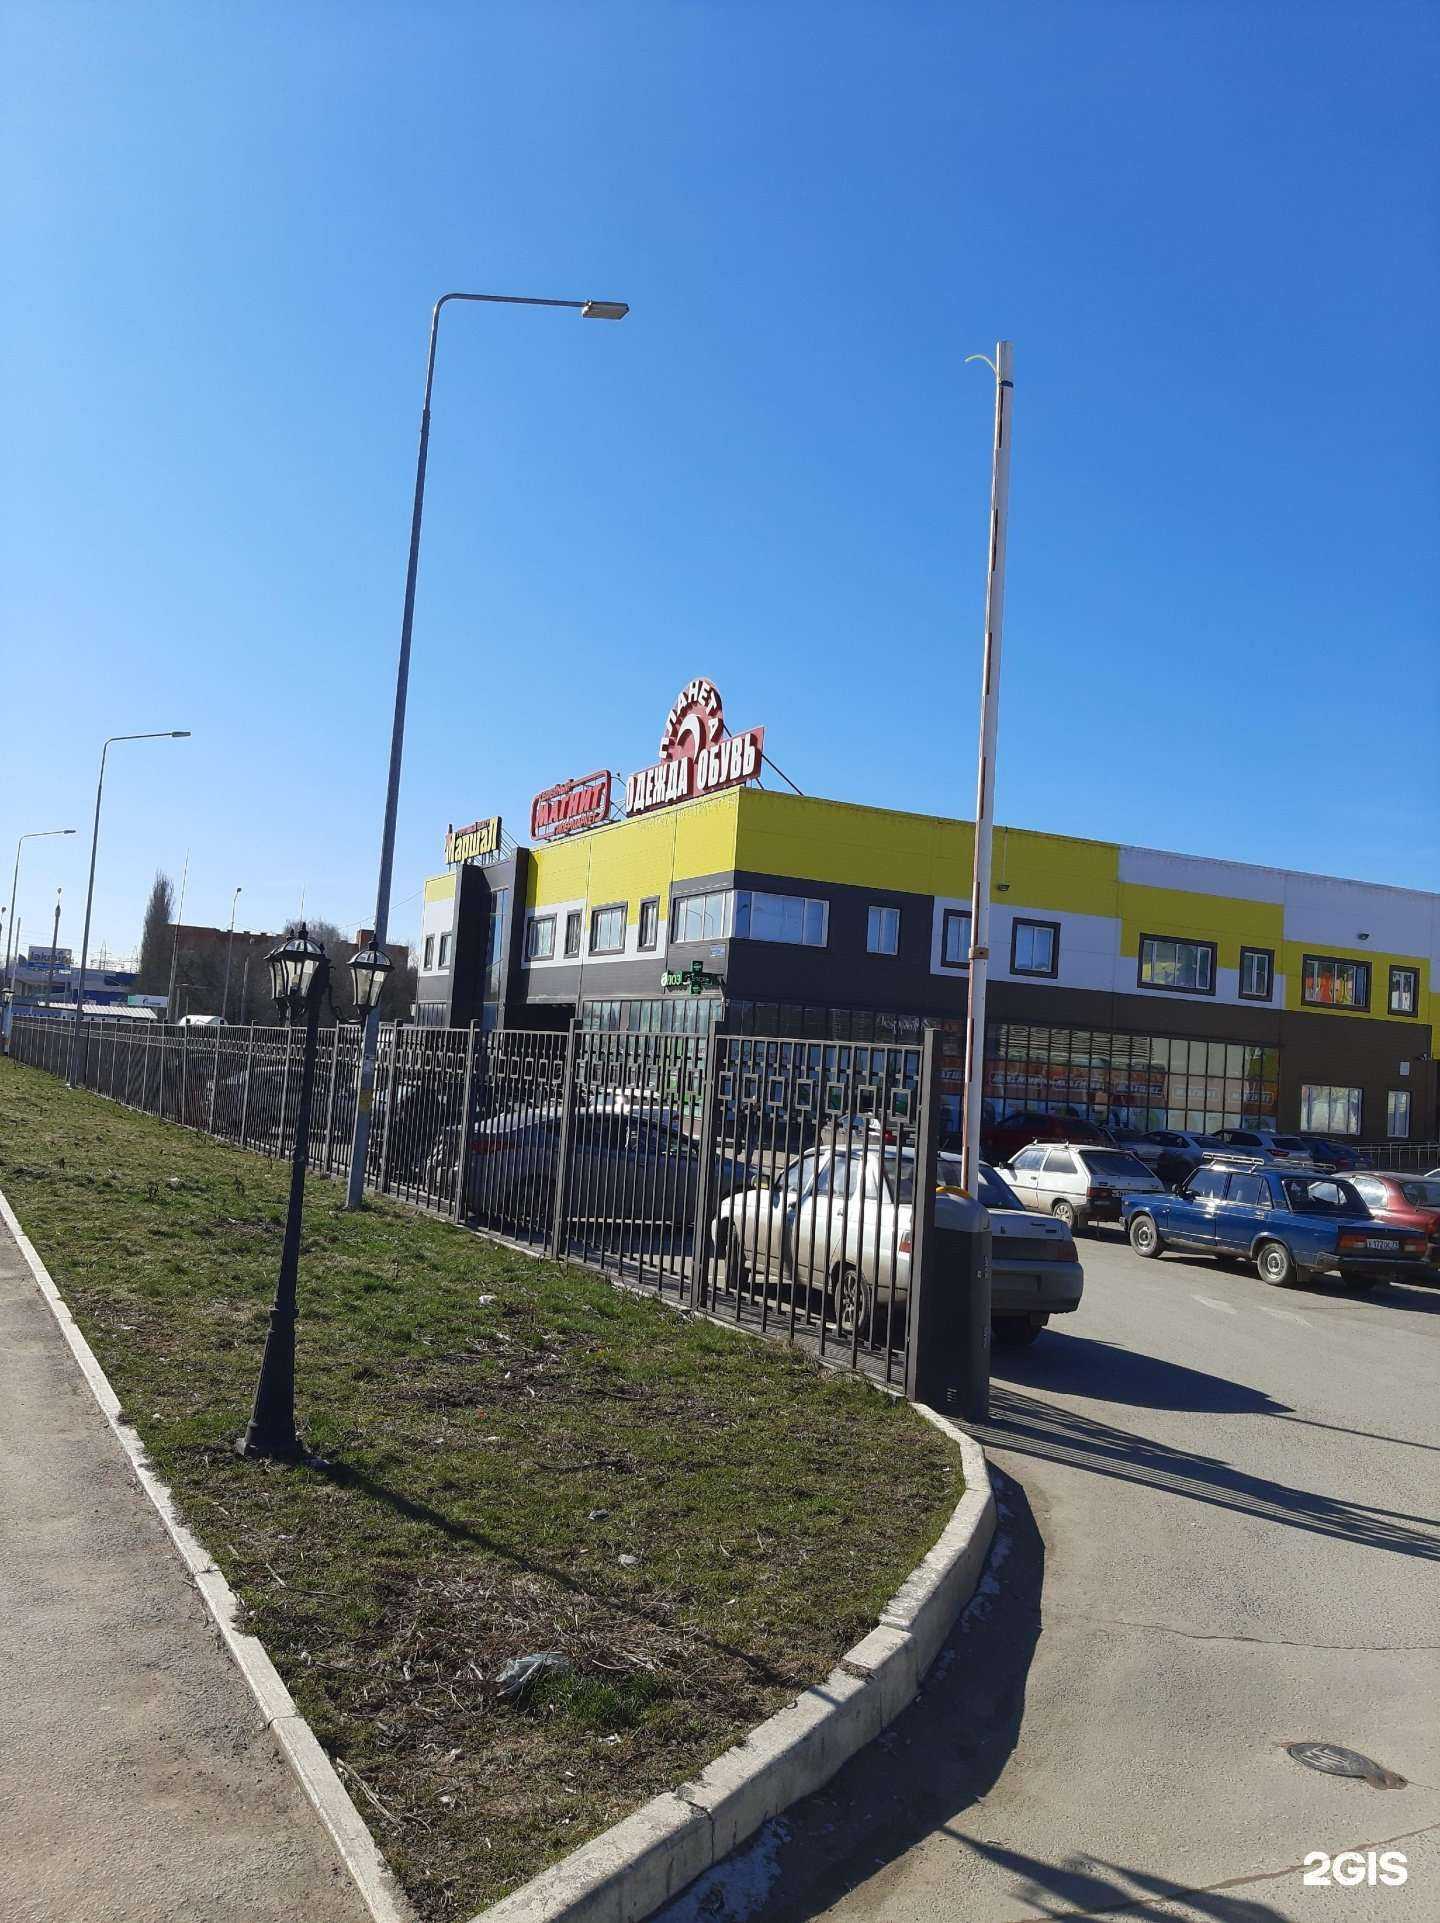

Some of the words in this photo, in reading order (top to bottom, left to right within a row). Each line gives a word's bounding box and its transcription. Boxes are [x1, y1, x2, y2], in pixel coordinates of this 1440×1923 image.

[625, 757, 688, 812] ОДЕЖДА
[697, 733, 755, 789] ОБУВЬ
[536, 782, 605, 828] МАГНИТ
